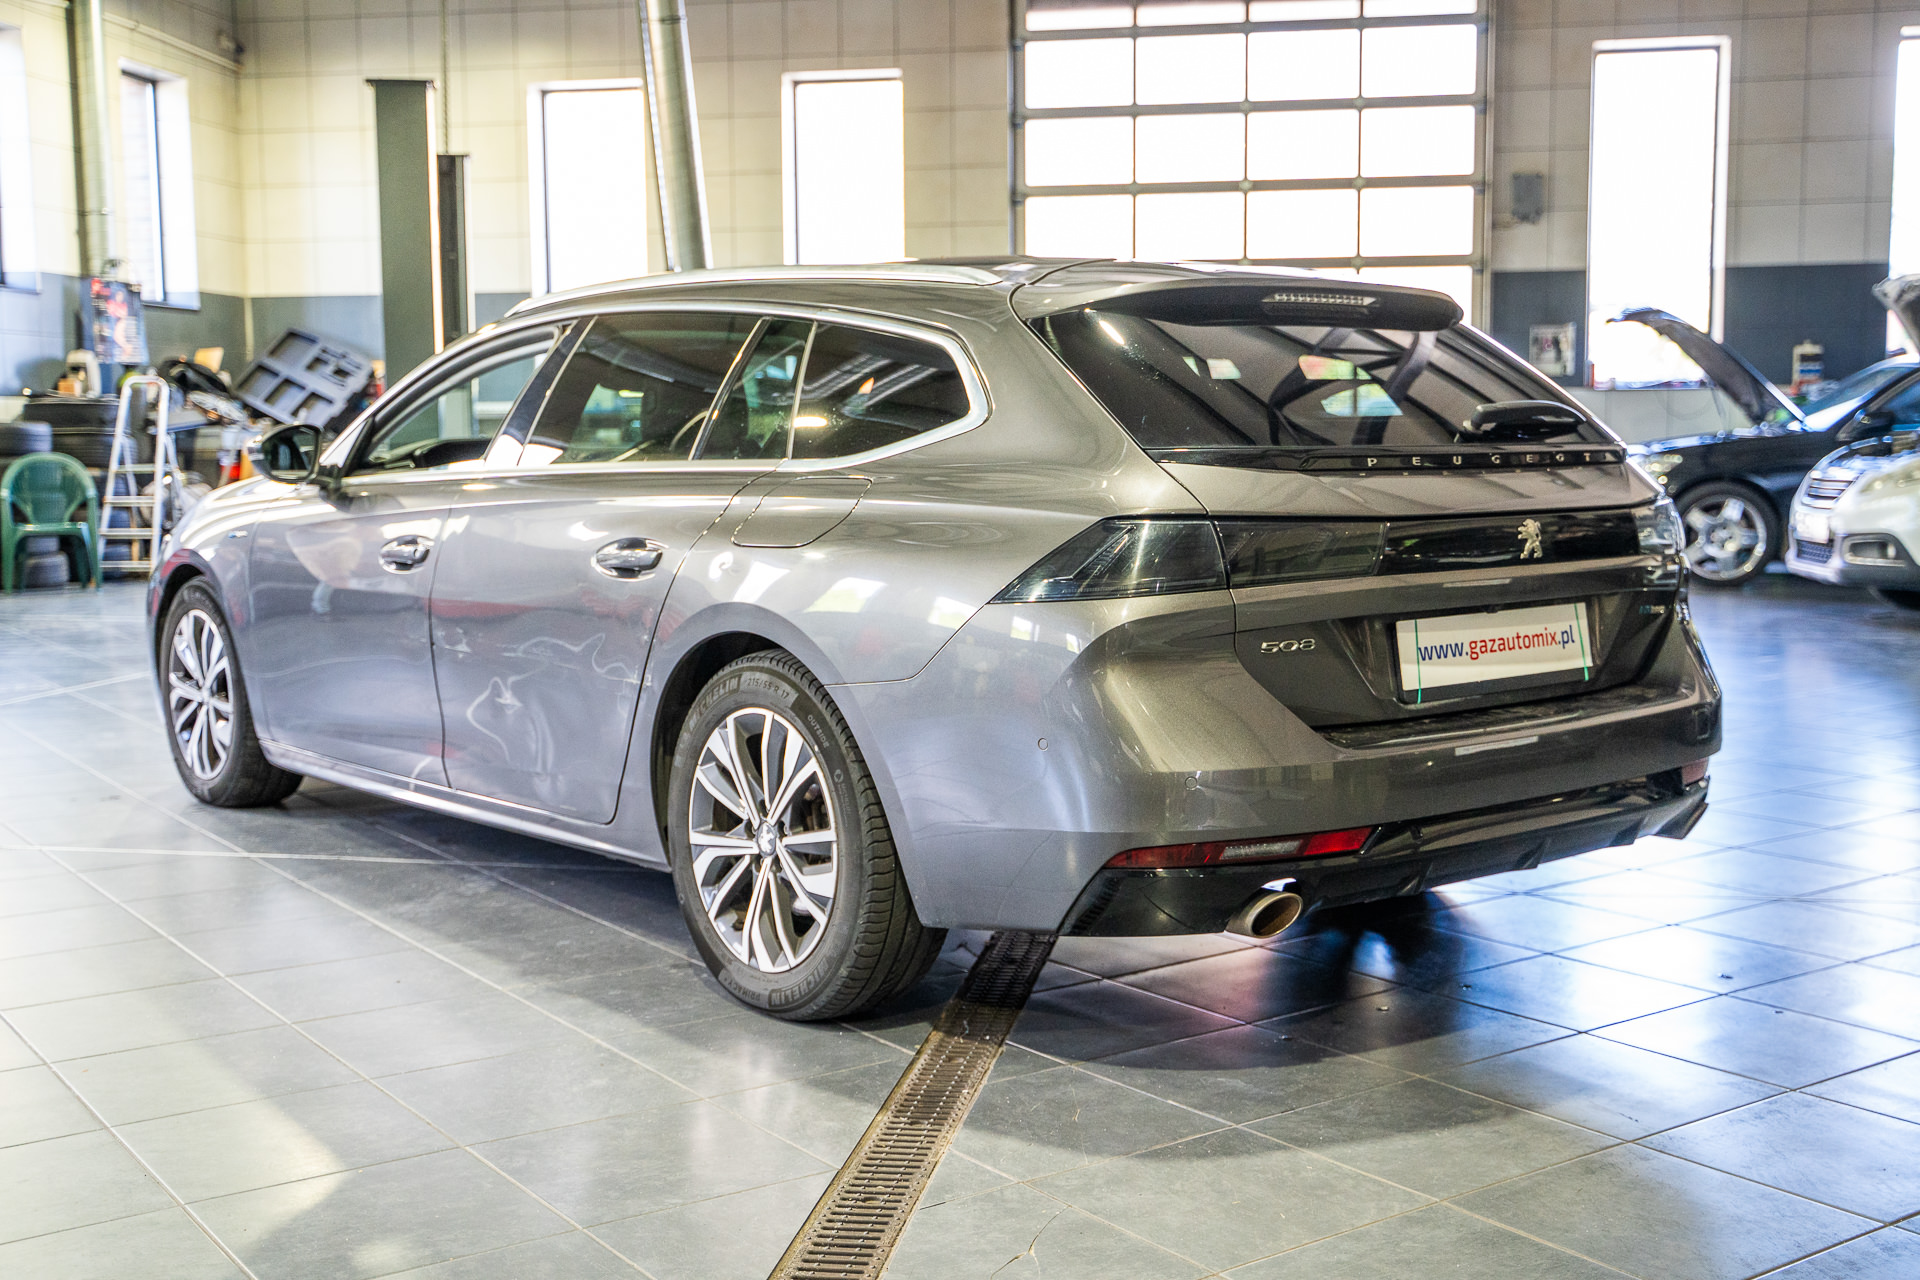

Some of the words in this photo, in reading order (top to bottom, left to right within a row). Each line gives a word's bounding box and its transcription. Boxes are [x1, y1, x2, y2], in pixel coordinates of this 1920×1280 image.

[1367, 453, 1592, 467] PEUGEOT
[1260, 638, 1317, 653] 508
[1418, 624, 1576, 662] www.gazautomix.pl
[747, 678, 772, 692] 215/55
[773, 685, 781, 695] R
[781, 689, 790, 701] 17
[807, 714, 830, 749] OUTSIDE
[728, 977, 762, 1002] PRIMACY
[771, 958, 829, 1006] MICHELIN
